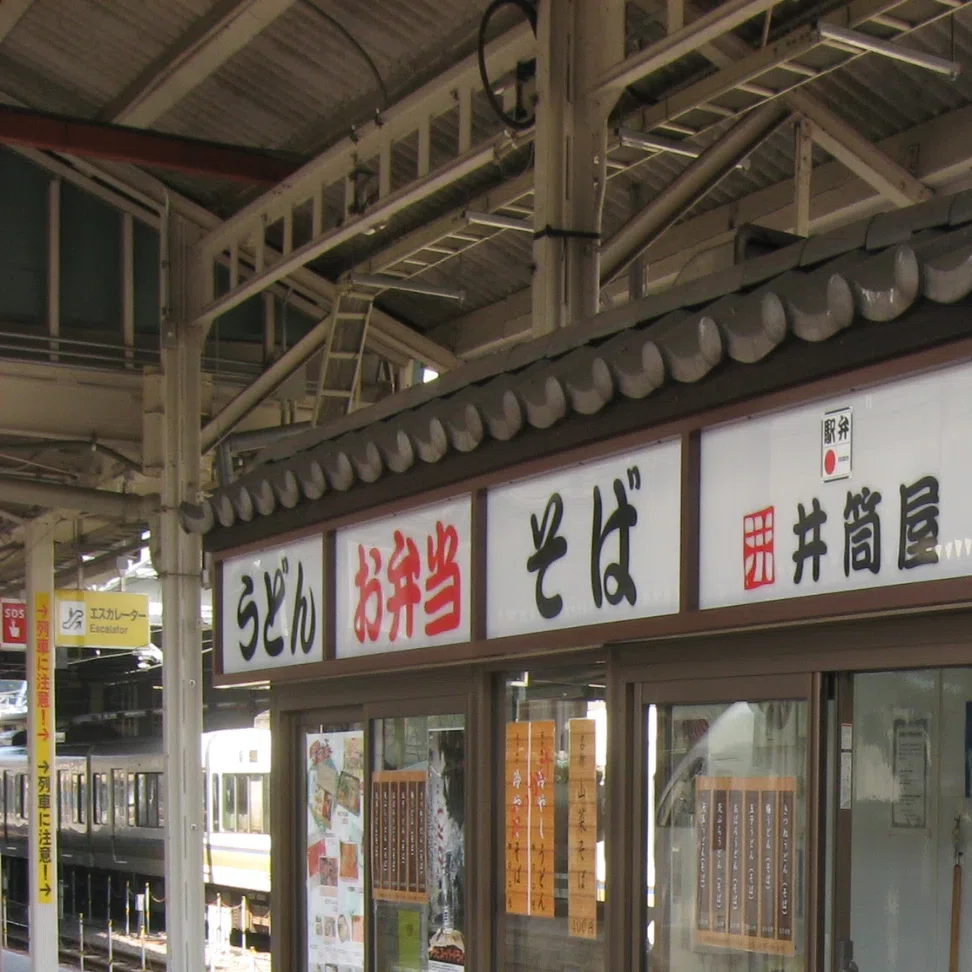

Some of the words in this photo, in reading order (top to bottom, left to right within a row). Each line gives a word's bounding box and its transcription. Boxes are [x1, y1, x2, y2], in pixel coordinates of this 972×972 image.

[824, 415, 850, 445] 駅弁
[526, 465, 641, 619] そば
[792, 475, 939, 584] 井筒屋
[5, 608, 25, 619] SOS
[90, 607, 146, 622] エスカレーター
[237, 556, 316, 661] うどん
[354, 521, 461, 643] お弁当
[90, 624, 128, 635] Escalator
